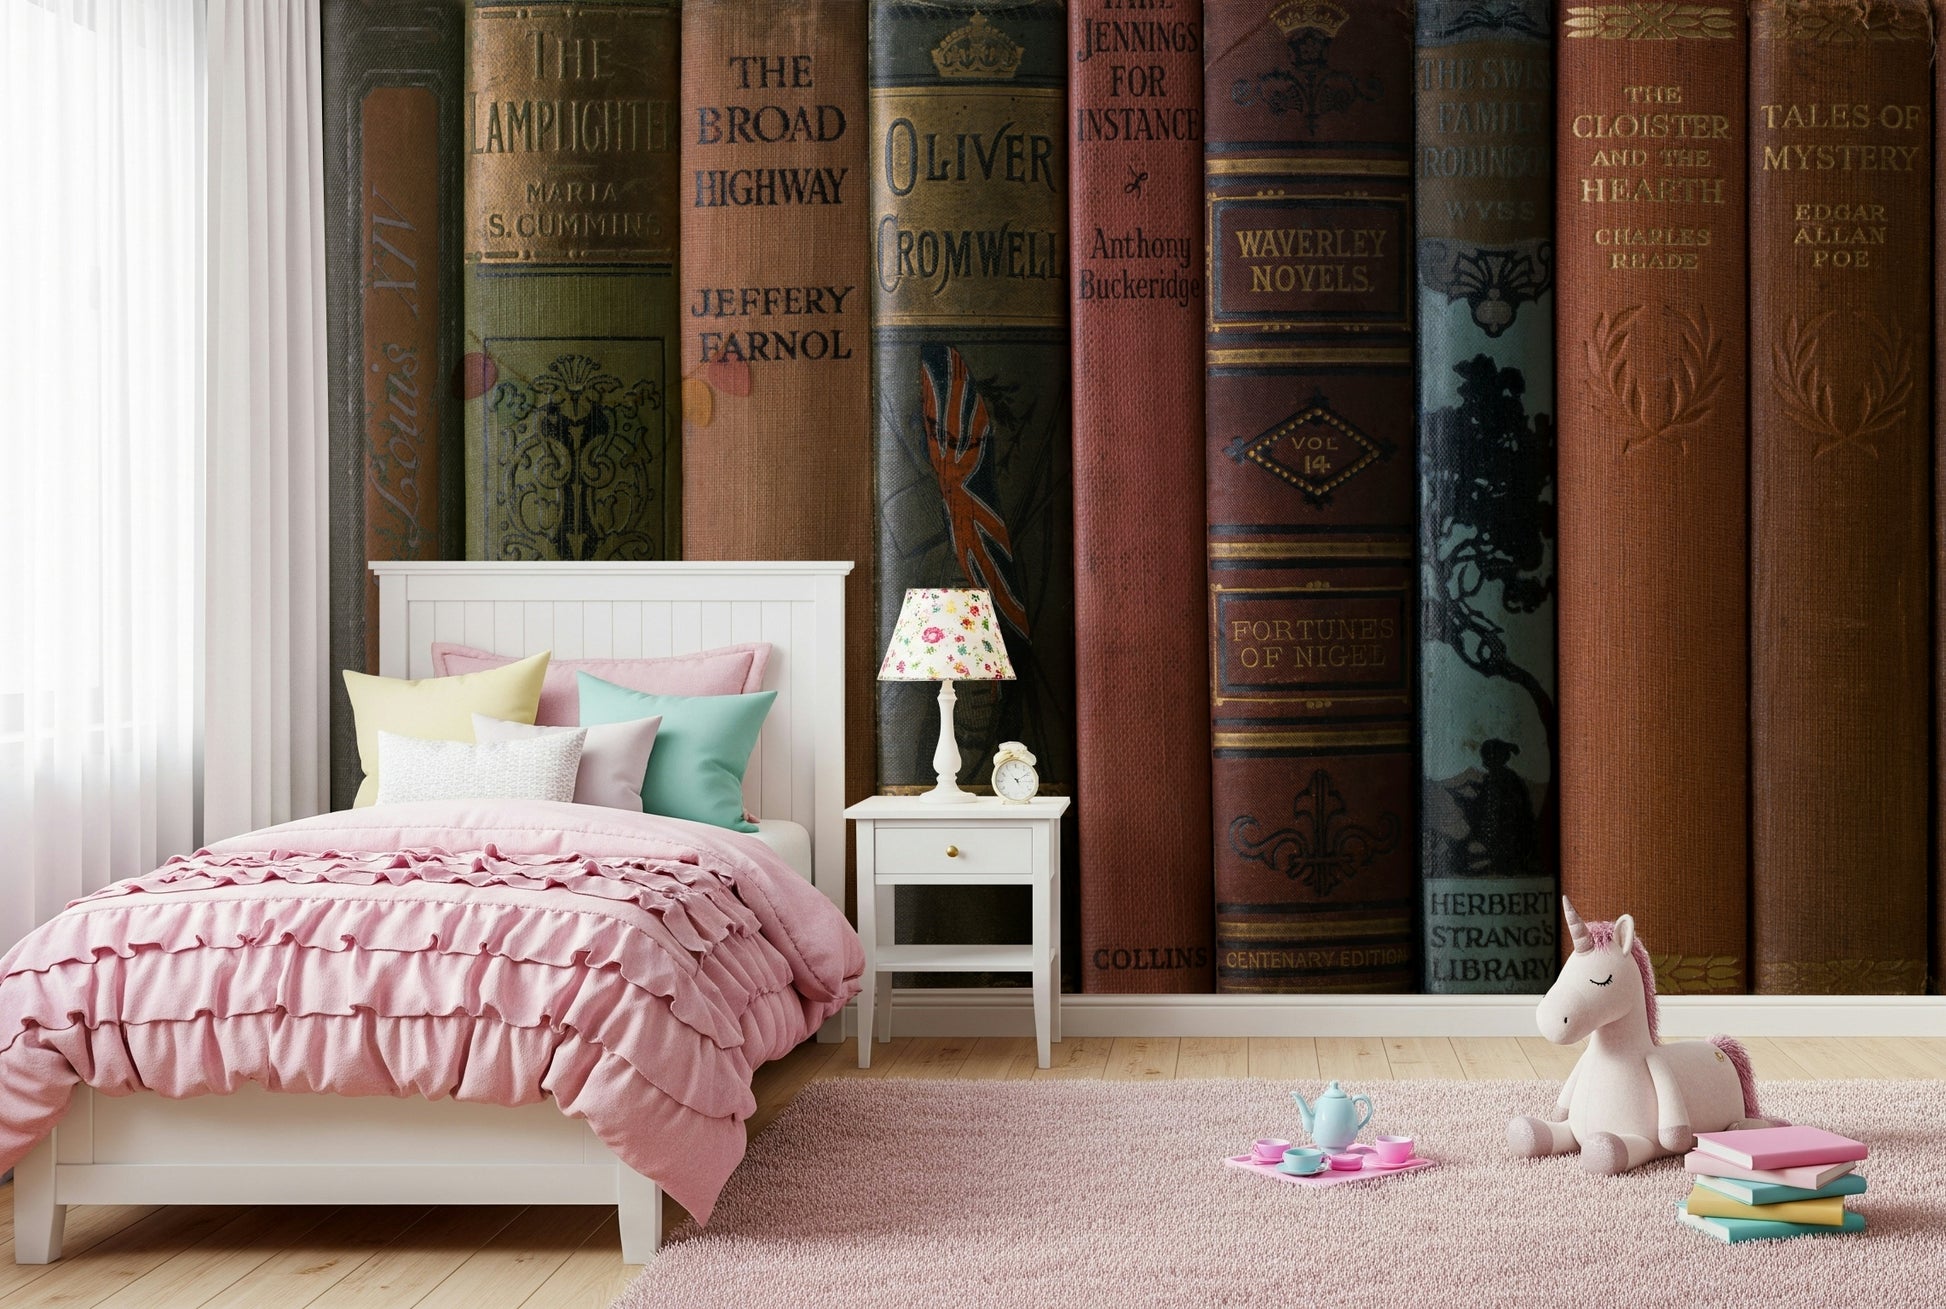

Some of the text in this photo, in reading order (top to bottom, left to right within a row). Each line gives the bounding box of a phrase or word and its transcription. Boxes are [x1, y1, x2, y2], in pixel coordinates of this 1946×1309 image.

[1077, 18, 1199, 63] JENNINGS
[526, 29, 617, 81] THE
[730, 55, 813, 90] THE
[1110, 66, 1166, 98] FOR
[1420, 57, 1551, 91] THE SWIS
[1624, 86, 1682, 103] THE
[697, 106, 847, 145] BROAD
[1077, 108, 1200, 141] INSTANCE
[1572, 113, 1732, 141] CLOISTER
[1760, 105, 1922, 131] TALES OF
[885, 118, 1056, 196] OLIVER
[1591, 149, 1712, 168] AND THE
[1761, 144, 1920, 172] MYSTERY
[526, 182, 617, 204] MARIA
[694, 168, 848, 208] HIGHWAY
[1580, 178, 1726, 203] HEARTH
[1445, 200, 1536, 221] WYSS
[1795, 204, 1888, 222] EDGAR
[1089, 227, 1191, 268] Anthony
[1235, 229, 1387, 258] WAVERLEY
[1594, 228, 1712, 247] CHARLES
[1793, 227, 1887, 245] ALLAN
[877, 214, 1063, 296] CROMWELL
[1610, 252, 1699, 270] READE
[1813, 250, 1870, 268] POE
[1079, 269, 1199, 307] Buckeridge
[692, 286, 856, 318] JEFFERY
[700, 331, 851, 363] FARNOL
[369, 182, 420, 548] Louis XIV
[1291, 437, 1339, 450] VOL
[1304, 455, 1331, 475] 14
[1231, 618, 1394, 642] FORTUNES
[1241, 644, 1386, 668] OF NIGEL
[1431, 892, 1552, 916] HERBERT
[1093, 947, 1207, 971] COLLINS
[1226, 948, 1408, 970] CENTENARY EDITION
[1432, 958, 1553, 982] LIBRARY
